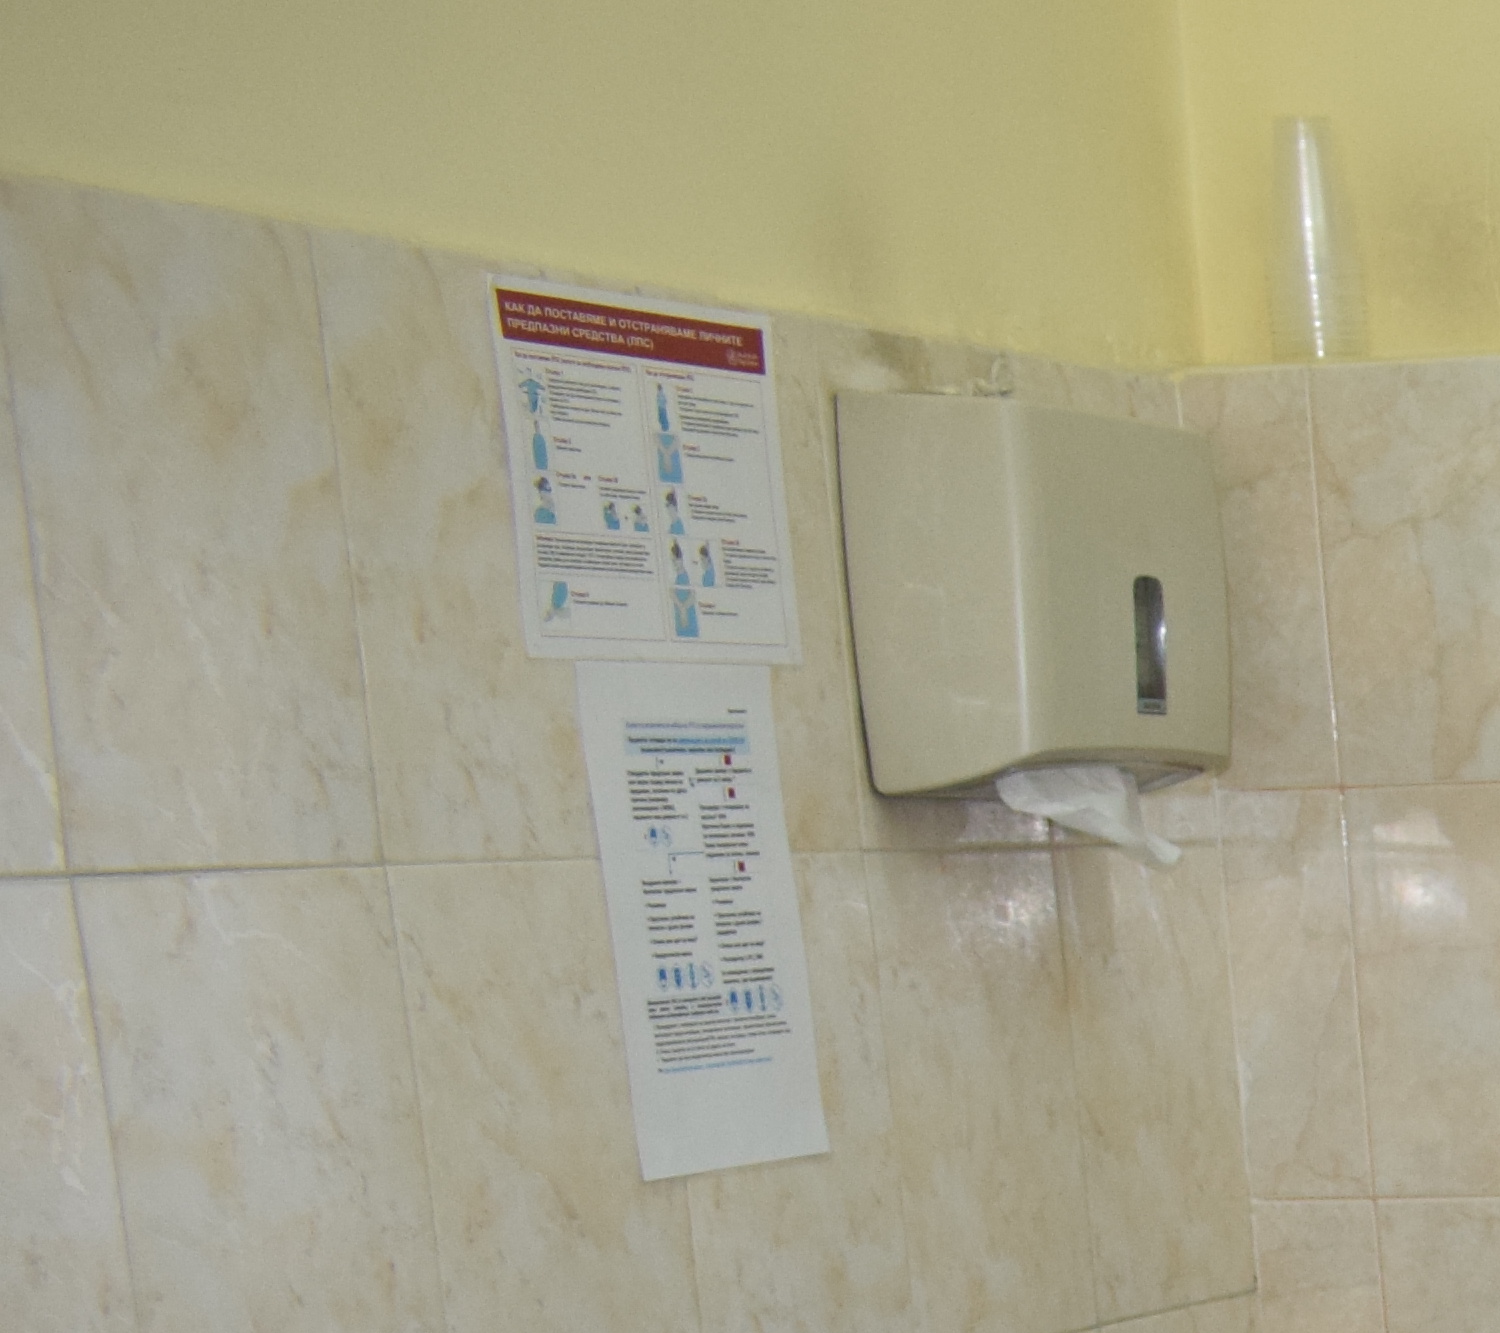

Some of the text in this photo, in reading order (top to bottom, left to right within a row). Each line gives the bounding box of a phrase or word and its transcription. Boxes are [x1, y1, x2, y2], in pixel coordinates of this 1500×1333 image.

[504, 302, 526, 314] КАК
[527, 305, 543, 317] ДА
[571, 328, 626, 345] СРЕДСТВА
